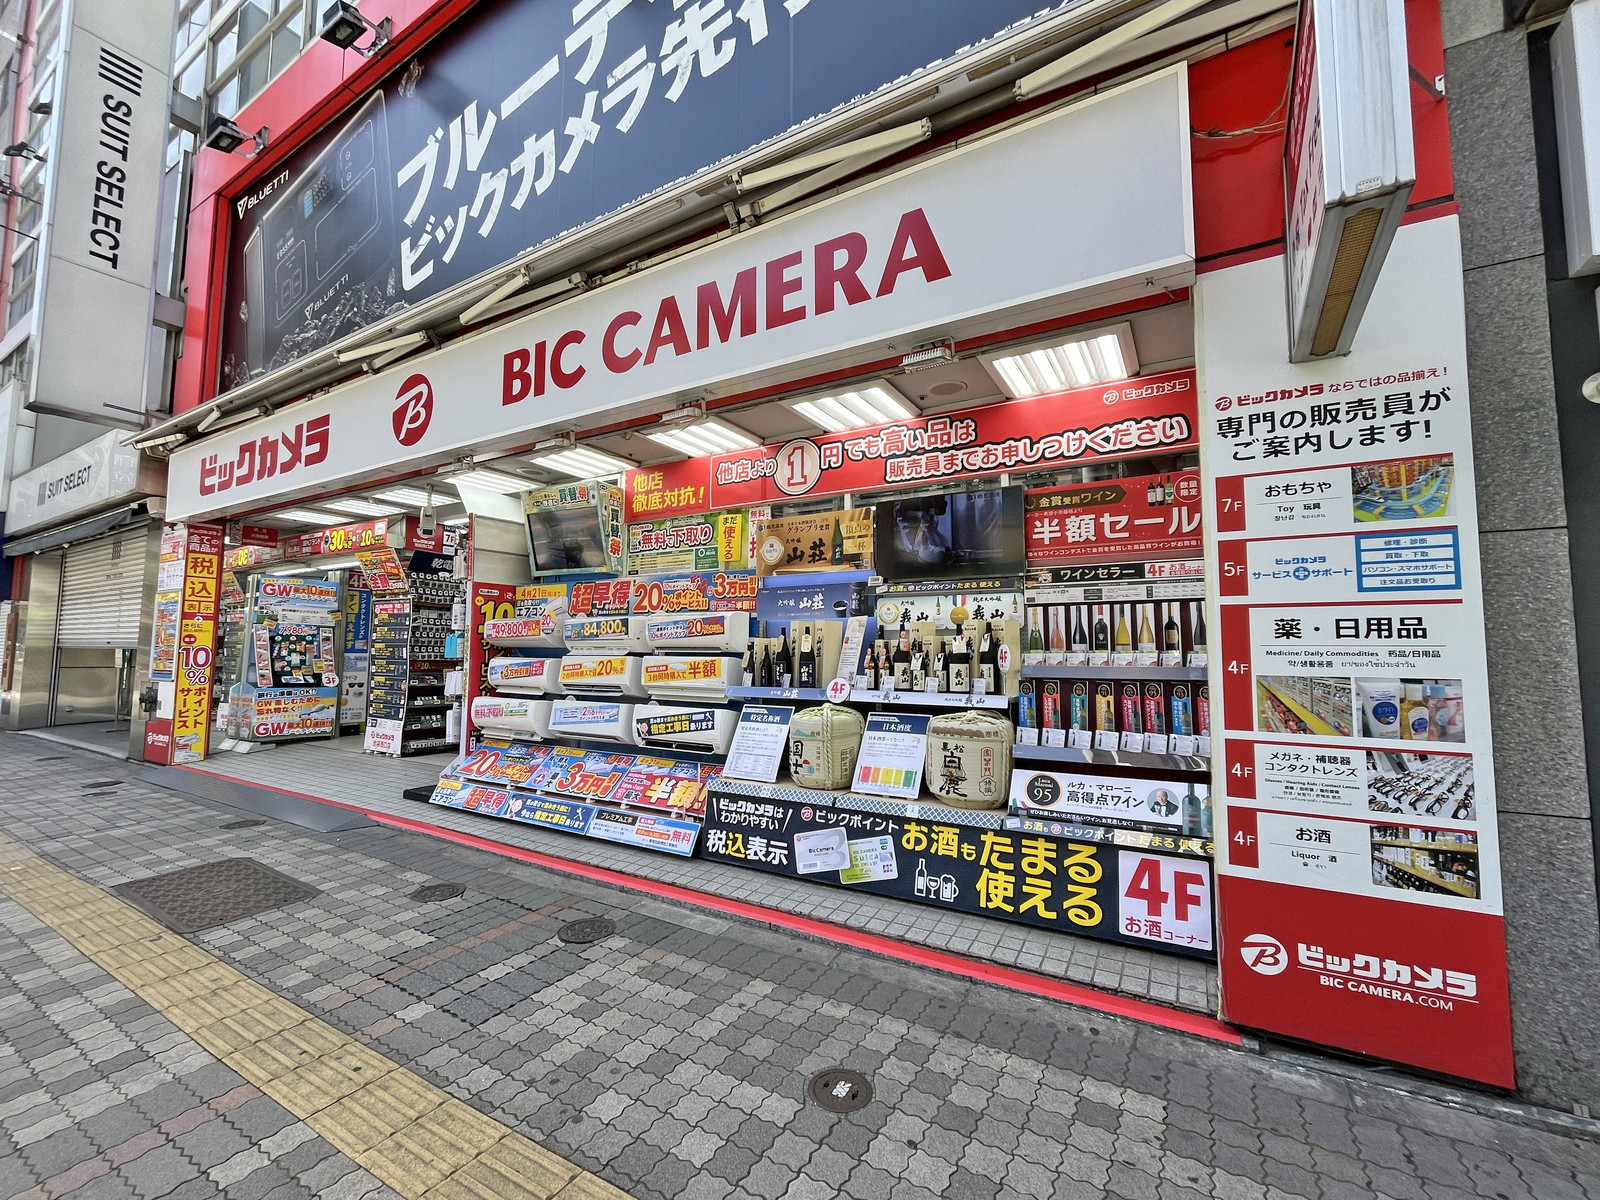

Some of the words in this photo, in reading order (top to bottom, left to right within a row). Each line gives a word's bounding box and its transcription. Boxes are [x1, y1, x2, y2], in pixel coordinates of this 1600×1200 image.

[397, 0, 634, 227] ブルーテ
[99, 94, 133, 162] SUIT
[247, 170, 289, 209] BLUETTI
[89, 157, 127, 270] SELECT
[313, 273, 349, 311] BLUETTI
[502, 329, 587, 407] BIC
[601, 207, 952, 375] CAMERA
[1122, 379, 1190, 401] ビックカメラ
[1238, 383, 1324, 406] ビックカメラ
[1328, 367, 1448, 393] ならではの品揃え!
[1217, 386, 1451, 439] 専門の販売員が
[1233, 419, 1432, 461] ご案内します!
[199, 413, 331, 497] ビックカメラ
[887, 418, 1189, 482] 販売員までお申しつけください
[47, 477, 64, 499] SUIT
[63, 465, 92, 492] SELECT
[632, 471, 664, 493] 他店
[1180, 480, 1197, 488] 数量
[1264, 480, 1332, 498] おもちゃ
[632, 486, 705, 513] 徹底対抗!
[1039, 490, 1117, 508] 金賞受賞ワイン
[1180, 488, 1199, 497] 限定
[1221, 498, 1243, 513] 7F
[1277, 505, 1295, 513] Toy
[722, 516, 738, 525] まだ
[787, 524, 830, 535] グランプリ受賞
[1032, 506, 1201, 545] 半額セール
[641, 524, 713, 549] 無料で下取り
[723, 526, 736, 560] 使える
[1224, 561, 1245, 576] 5F
[1275, 555, 1327, 565] ビックカメラ
[1363, 563, 1453, 573] パソコン・スマホサポート
[1060, 567, 1136, 581] ワインセラー
[1147, 563, 1166, 576] 4F
[1252, 570, 1292, 579] サービス
[1311, 567, 1353, 577] サポート
[262, 582, 293, 598] GW
[569, 579, 633, 616] 超早得
[633, 581, 675, 613] 20%
[675, 589, 702, 600] ポイント
[798, 593, 825, 610] 山荘
[516, 606, 546, 617] エアコン
[1274, 617, 1428, 640] 薬・日用品
[178, 645, 213, 670] 10
[1303, 650, 1325, 658] Daily
[688, 659, 717, 679] 半額
[1227, 660, 1249, 675] 4F
[185, 668, 210, 686] %
[324, 676, 337, 685] 3F
[830, 681, 846, 695] 4F
[177, 687, 193, 730] サービス
[193, 687, 207, 729] ポイント
[256, 699, 273, 708] GW
[750, 713, 781, 723] 特定名称酒
[255, 720, 288, 736] GW
[650, 720, 714, 736] 指定工事日承ります
[882, 723, 912, 732] 日本酒度
[941, 741, 965, 753] 黒松
[1270, 752, 1351, 766] メガネ・補聴器
[671, 766, 697, 776] エアコン
[1231, 762, 1253, 778] 4F
[1264, 762, 1358, 778] コンタクトレンズ
[624, 789, 642, 801] 最大
[1033, 788, 1052, 802] 95
[1067, 781, 1133, 794] ルカ・マローニ
[719, 797, 784, 819] ビックカメラは
[1066, 790, 1144, 809] 高得点ワイン
[720, 812, 779, 831] わかりやすい
[815, 809, 900, 833] ビックポイント
[670, 829, 693, 845] 無料
[1023, 820, 1049, 833] お酒も
[1064, 825, 1137, 842] ビックポイント
[1139, 834, 1175, 848] たまる
[1233, 830, 1255, 847] 4F
[1295, 827, 1332, 844] お酒
[706, 828, 789, 866] 税込表示
[808, 846, 834, 854] BicCamera
[901, 821, 977, 862] お酒も
[980, 830, 1104, 885] たまる
[1291, 850, 1320, 861] Liquor
[853, 853, 879, 861] Suica
[975, 868, 1104, 927] 使える
[1124, 857, 1206, 922] 4F
[1125, 916, 1209, 945] お酒コーナー
[1297, 942, 1477, 998] ビックカメラ
[1319, 975, 1344, 989] BIC
[1347, 980, 1454, 1012] CAMERA.COM
